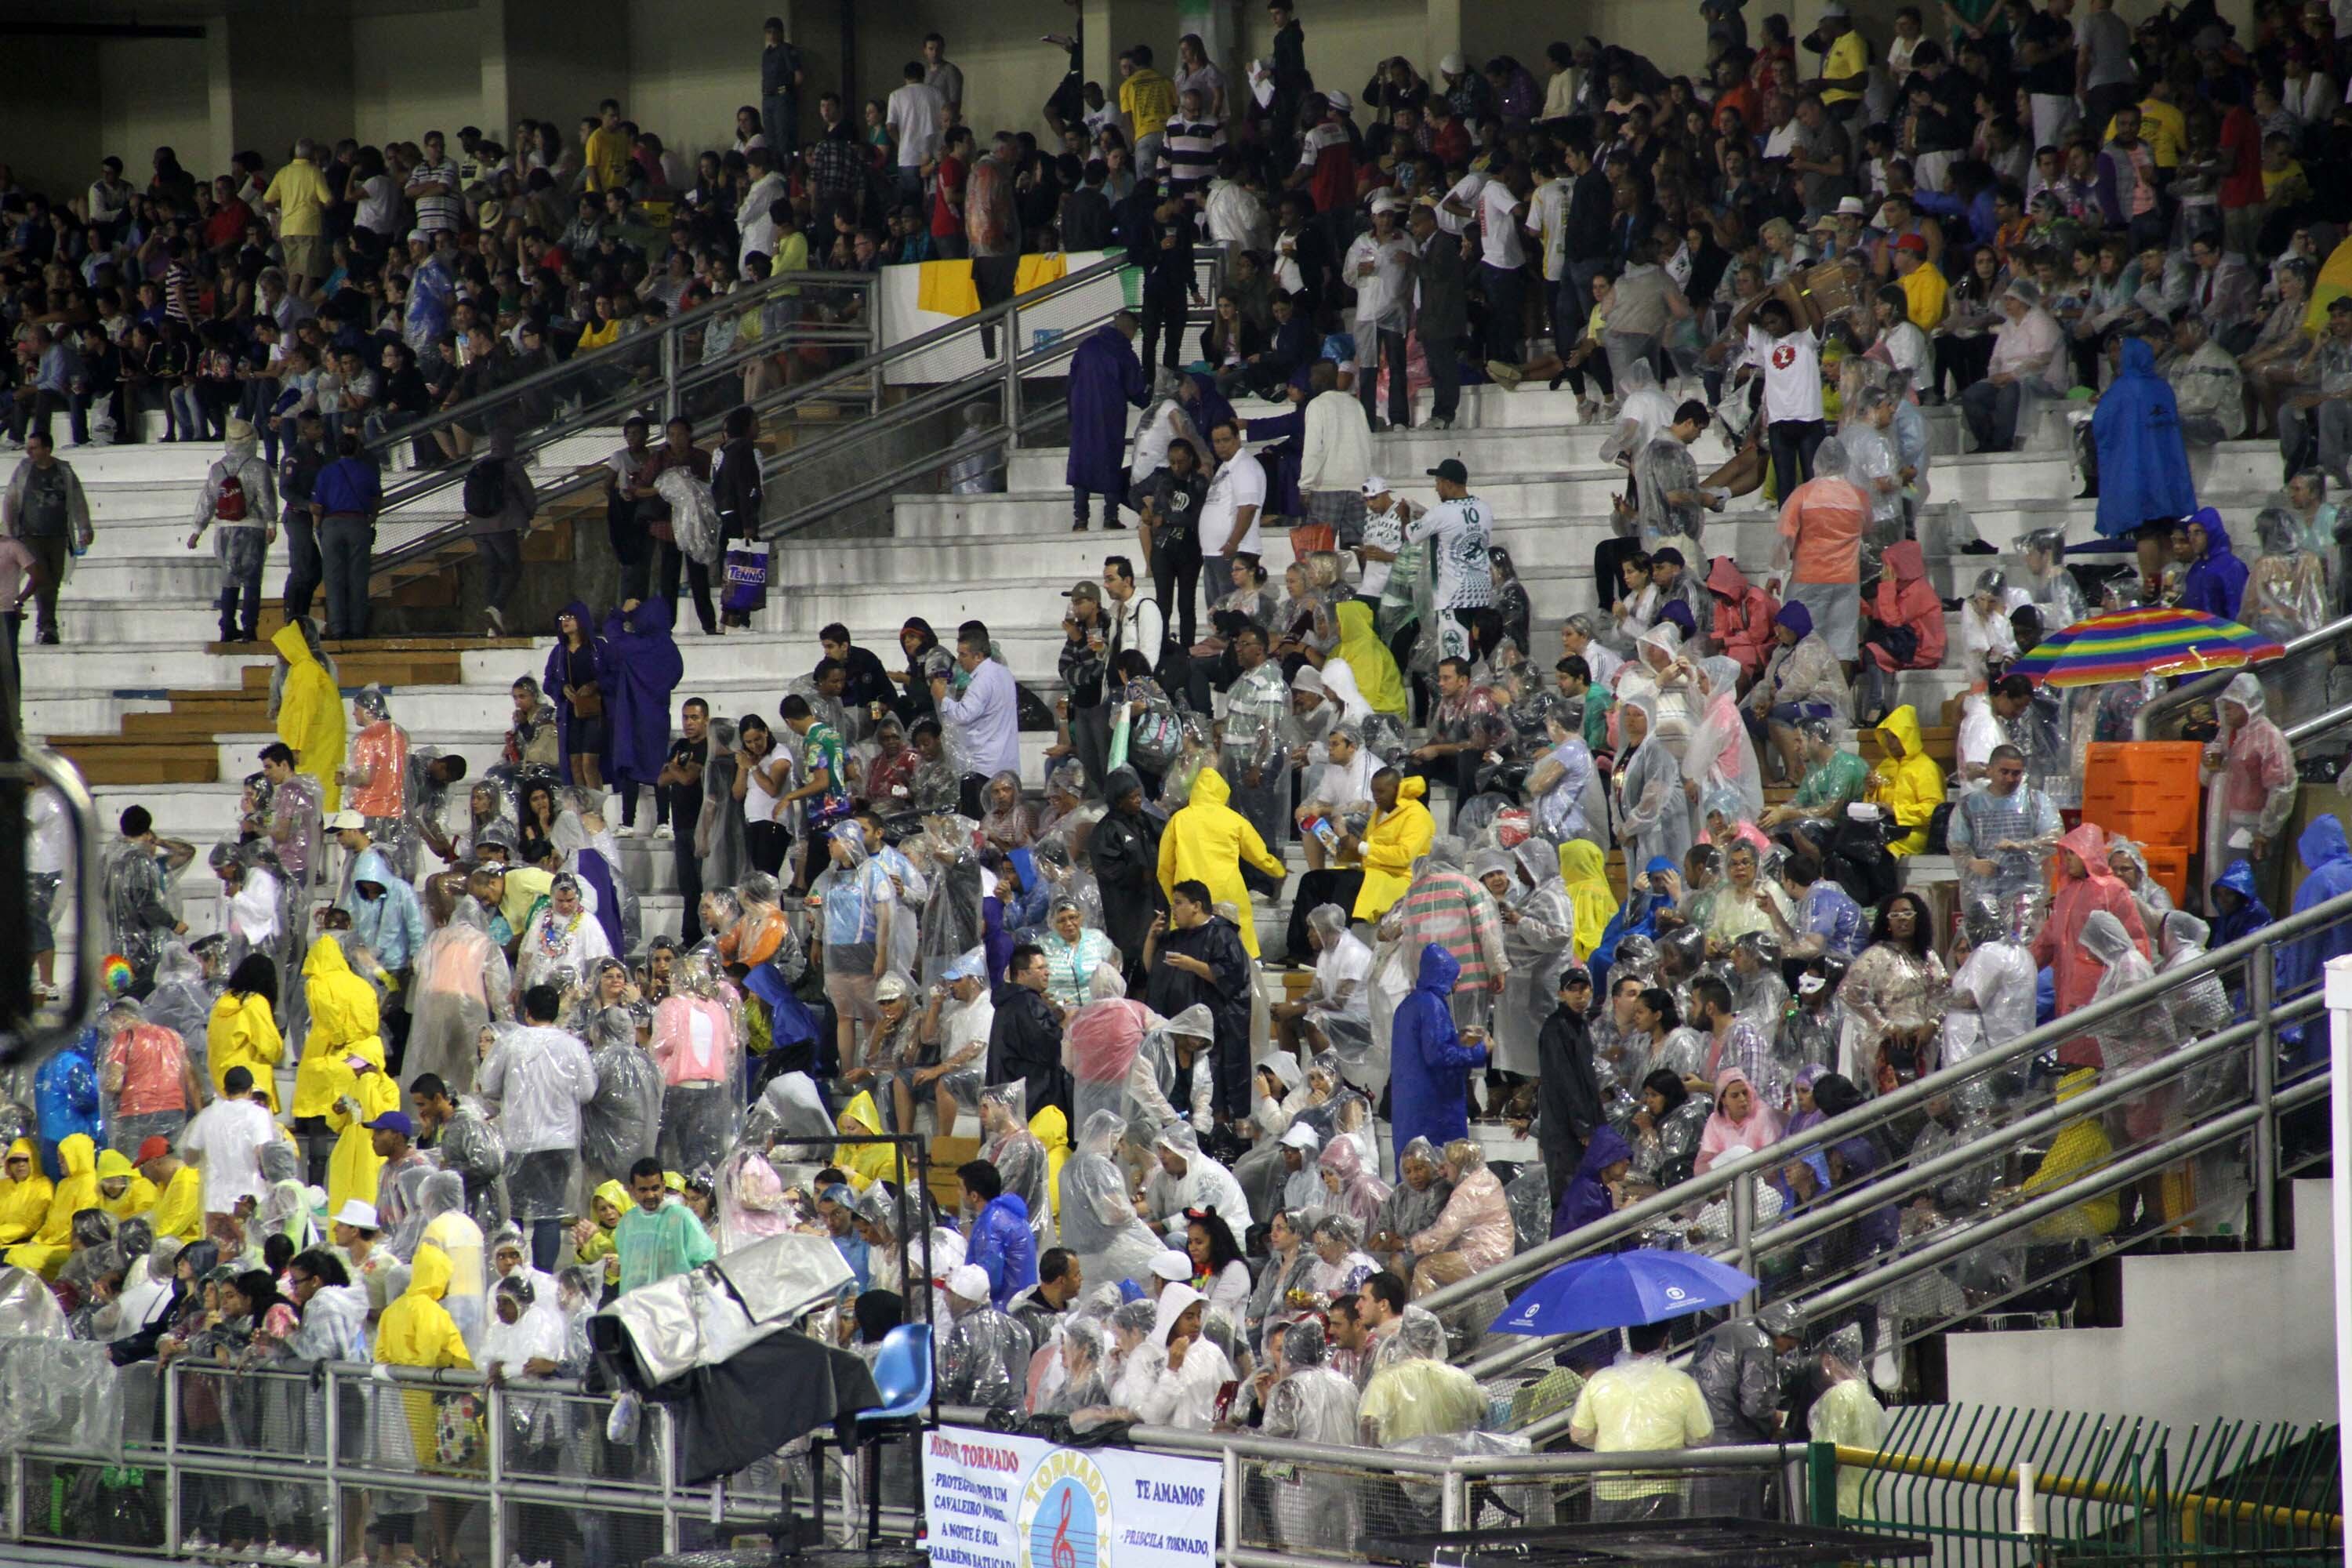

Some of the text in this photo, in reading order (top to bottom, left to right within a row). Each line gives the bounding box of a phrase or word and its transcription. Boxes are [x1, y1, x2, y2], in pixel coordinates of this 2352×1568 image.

[1461, 507, 1479, 524] 10
[729, 566, 764, 582] TENNIS
[961, 1444, 1018, 1474] TORNADO
[994, 1486, 1007, 1502] UM
[1025, 1450, 1109, 1516] TORNADO
[1135, 1479, 1205, 1506] TE AMAMOS
[934, 1494, 982, 1515] CAVALEIRO
[942, 1522, 999, 1546] A NOITE É SUA
[927, 1544, 972, 1566] PARABÉNS
